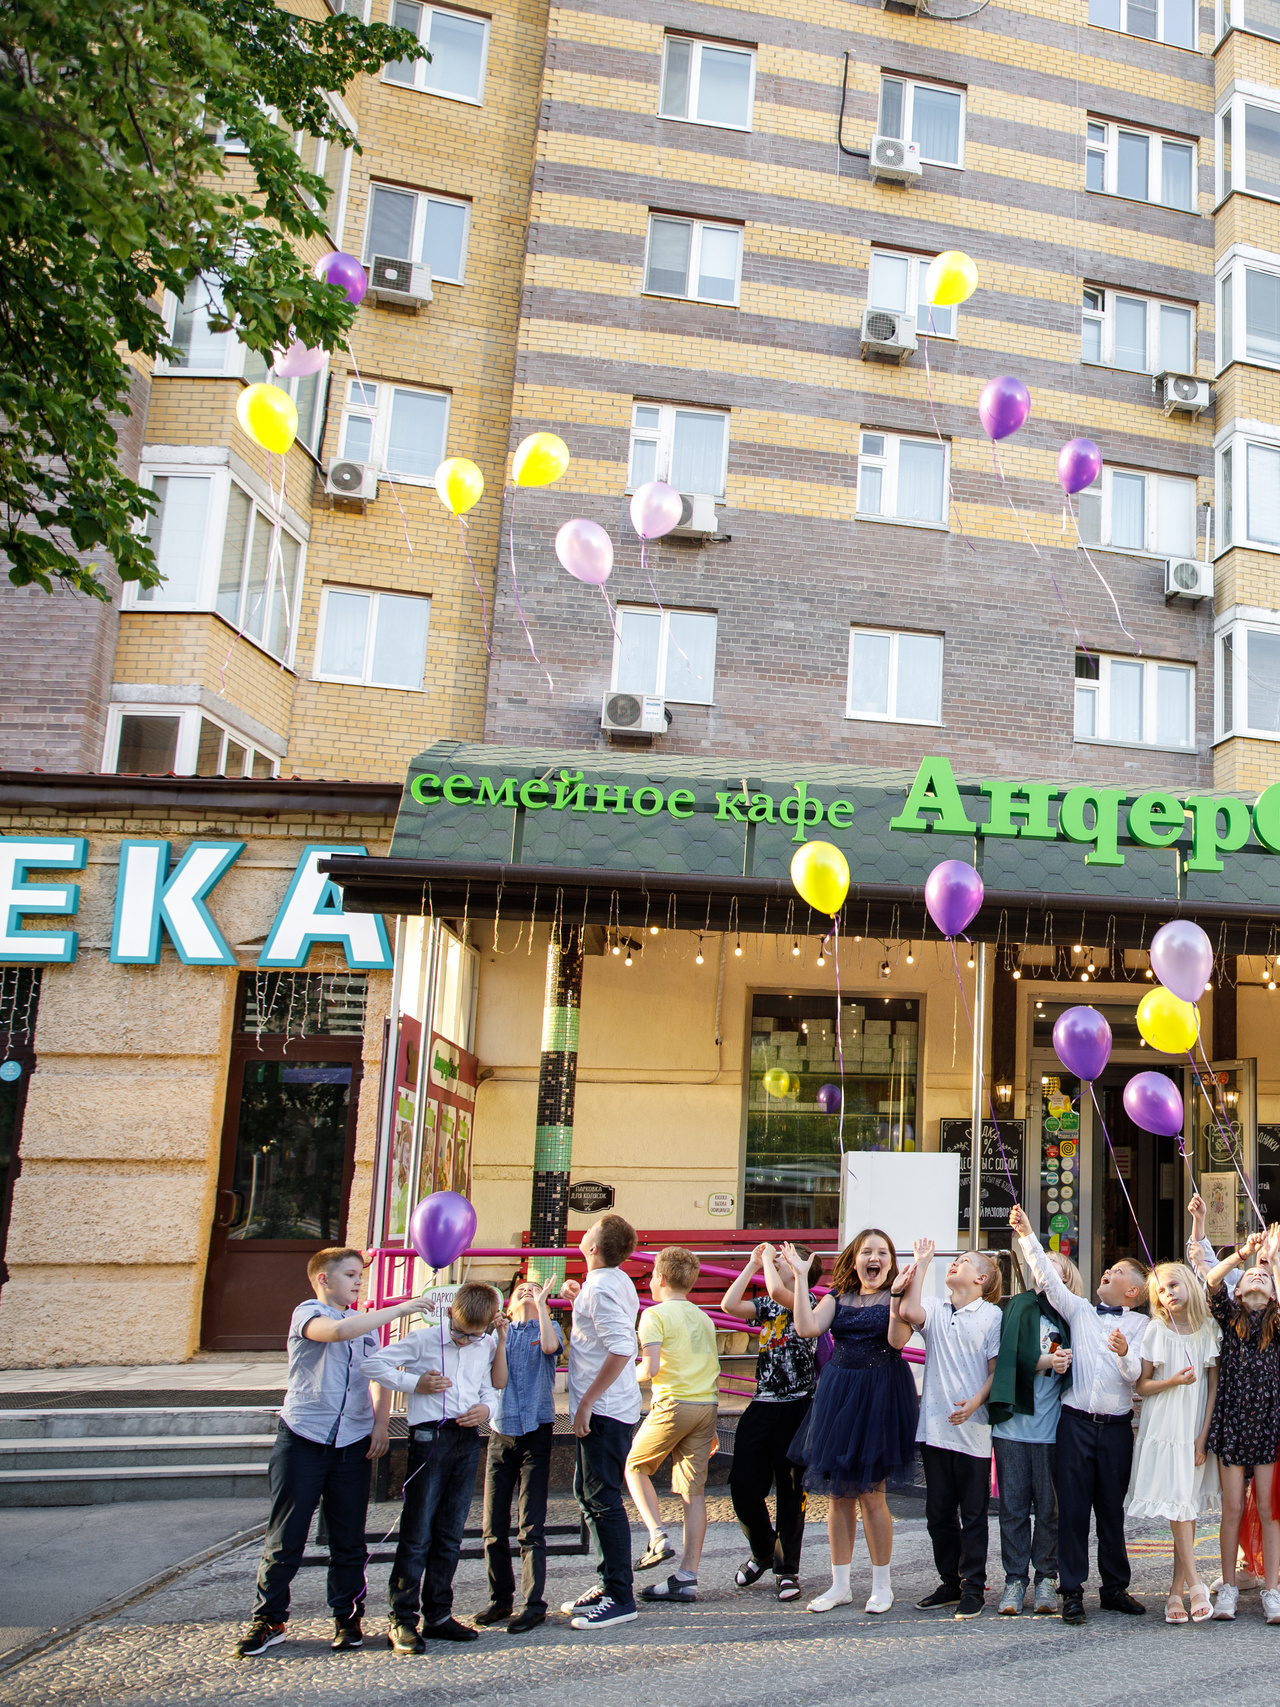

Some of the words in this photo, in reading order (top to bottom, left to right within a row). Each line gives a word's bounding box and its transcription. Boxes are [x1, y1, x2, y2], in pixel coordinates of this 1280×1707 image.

[411, 770, 696, 820] семейное
[714, 781, 855, 842] кафе
[431, 1291, 457, 1304] ПАРКО
